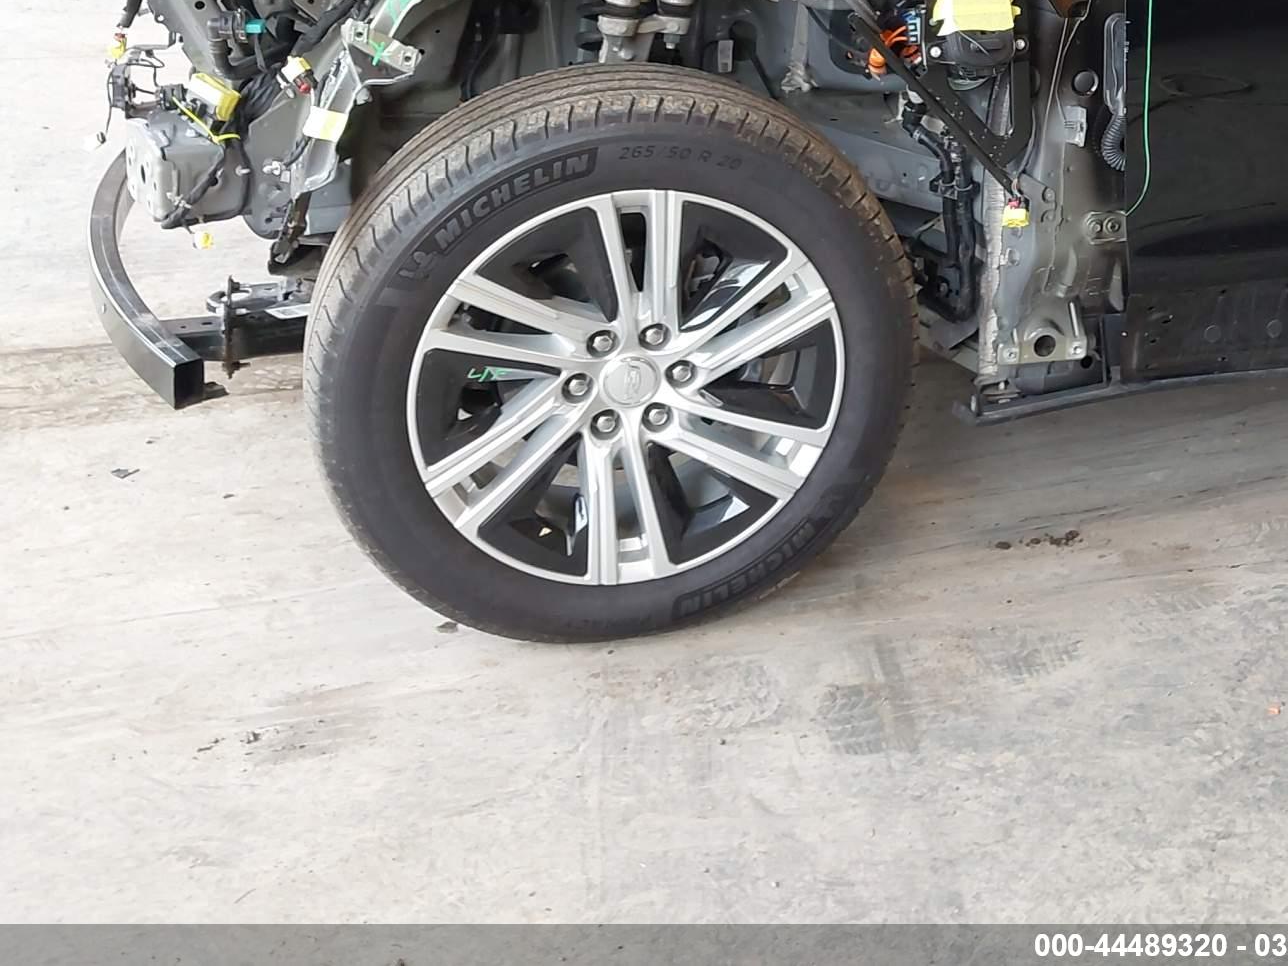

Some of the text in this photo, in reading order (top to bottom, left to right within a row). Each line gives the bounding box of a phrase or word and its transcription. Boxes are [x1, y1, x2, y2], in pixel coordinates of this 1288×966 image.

[433, 153, 590, 252] MICHELIN
[698, 149, 713, 163] R
[678, 519, 818, 618] MICHELIN
